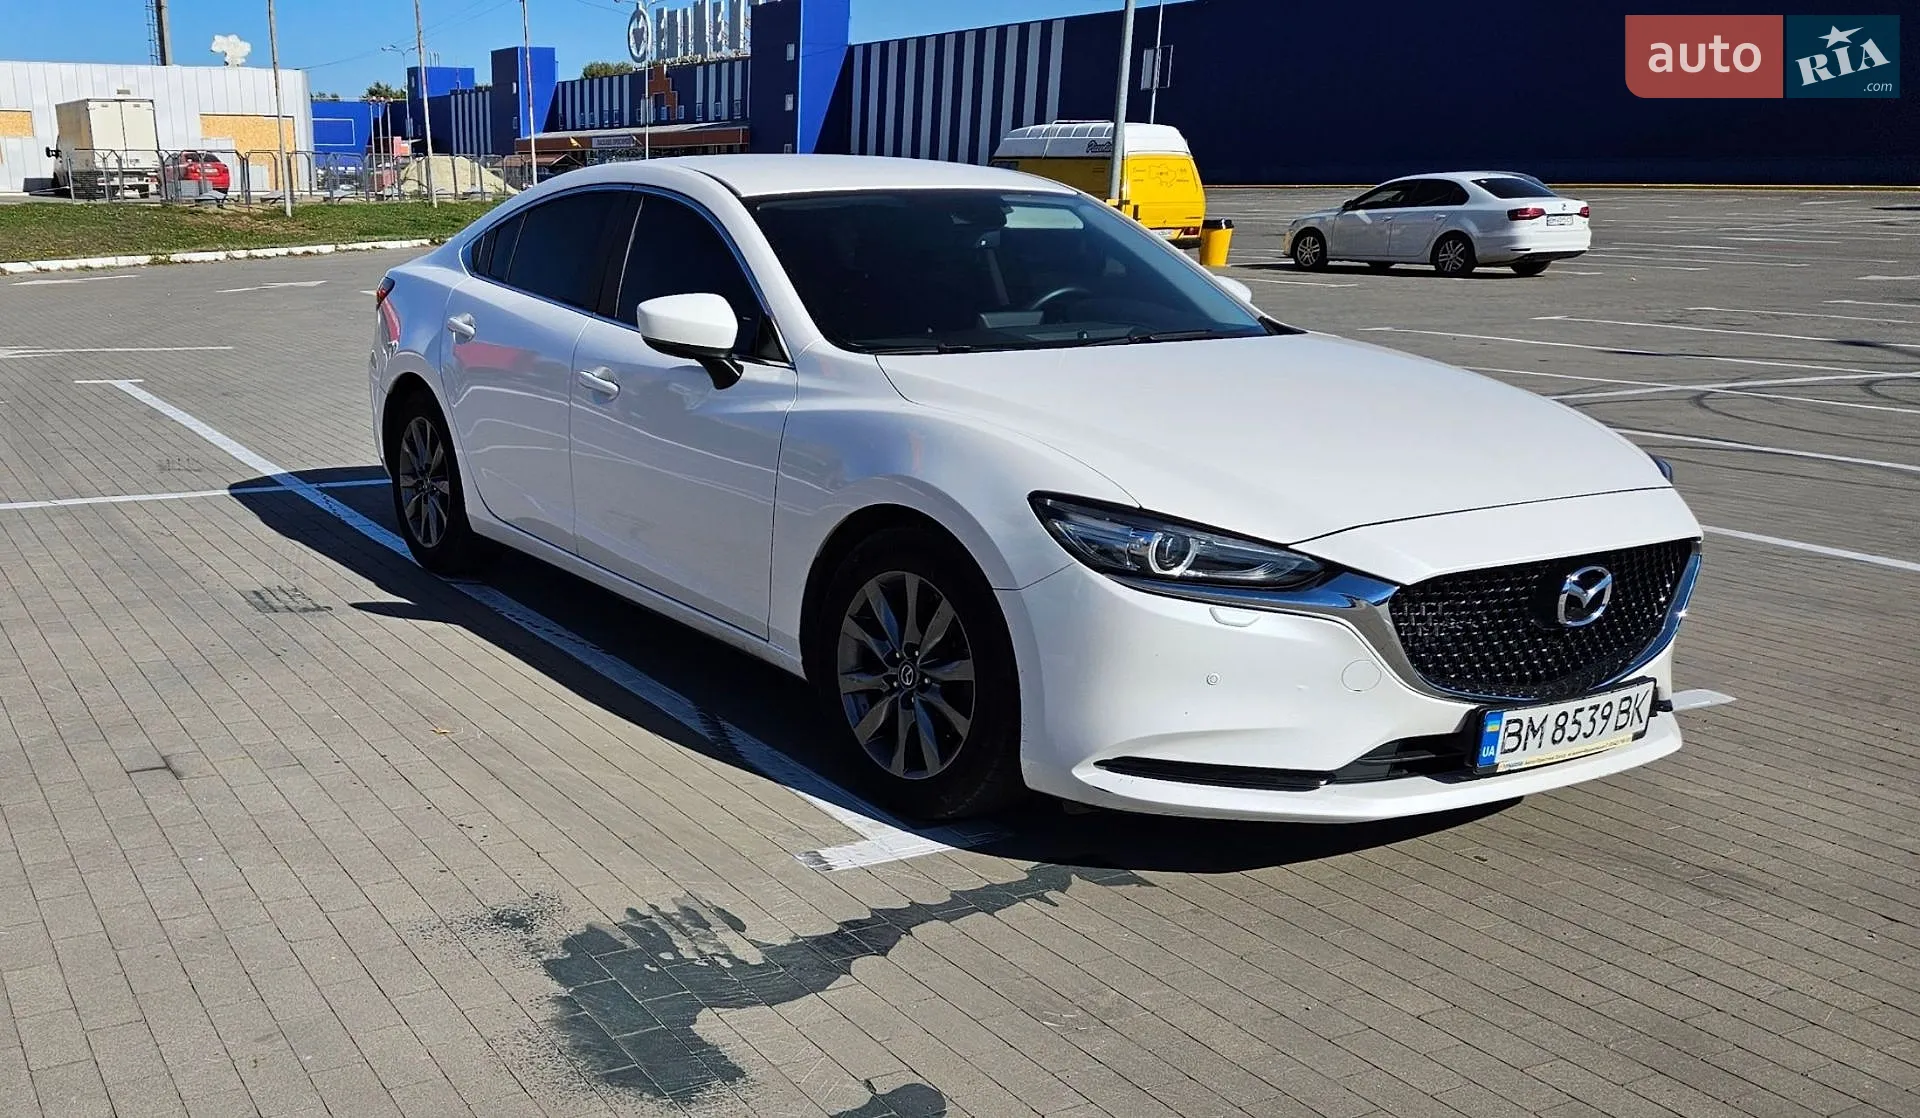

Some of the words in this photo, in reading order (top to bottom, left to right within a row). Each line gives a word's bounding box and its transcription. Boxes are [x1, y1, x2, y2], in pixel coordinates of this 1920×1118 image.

[1500, 713, 1549, 754] BM
[1551, 701, 1613, 745] 8539
[1614, 689, 1650, 732] BK
[1482, 745, 1495, 758] UA
